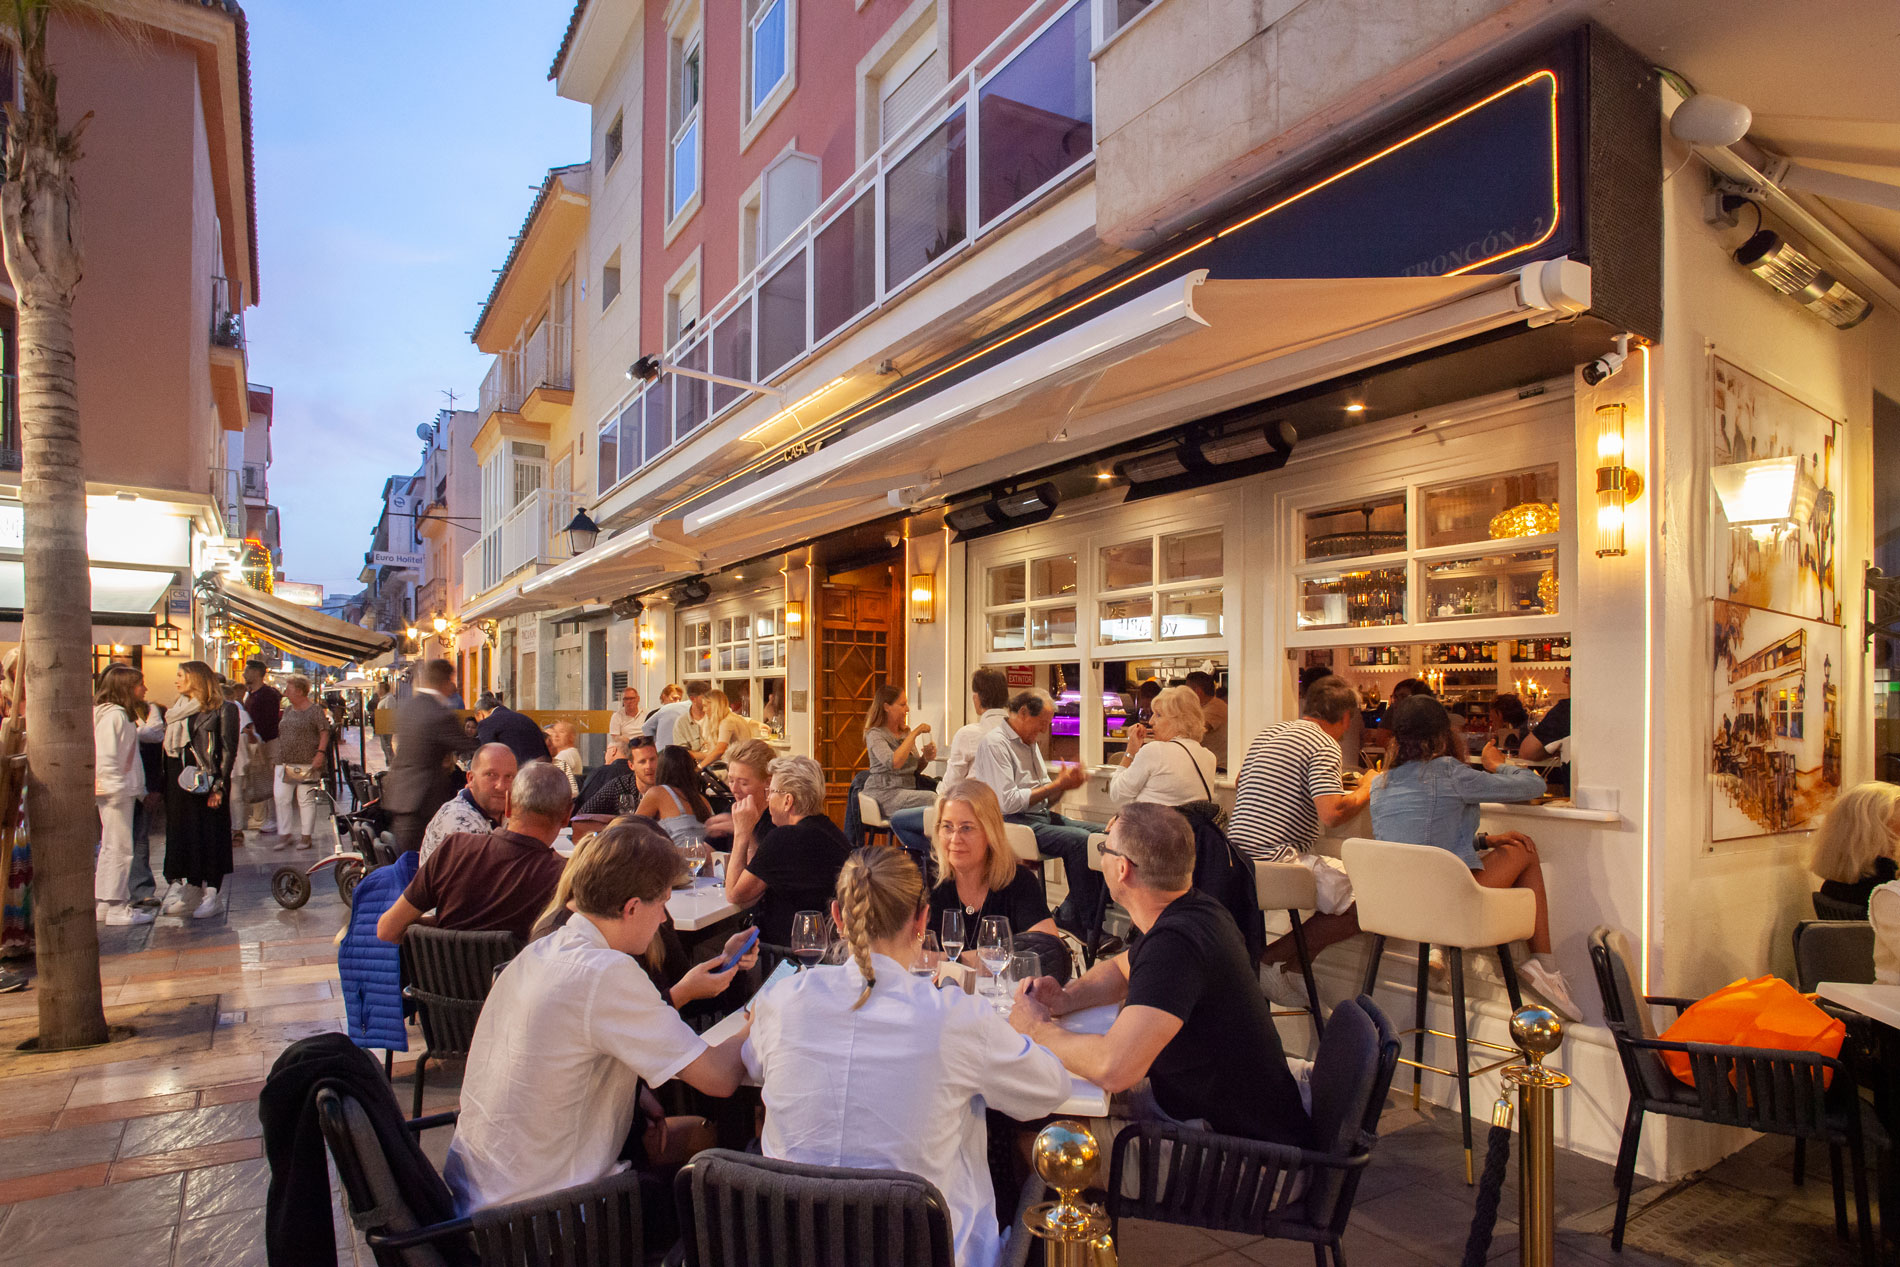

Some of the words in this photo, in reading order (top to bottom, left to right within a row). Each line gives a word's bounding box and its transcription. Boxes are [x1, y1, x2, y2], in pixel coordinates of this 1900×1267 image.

[783, 441, 808, 462] CASA
[375, 554, 394, 562] Euro
[396, 555, 423, 564] Holitel
[1008, 674, 1032, 683] EXTINTOR
